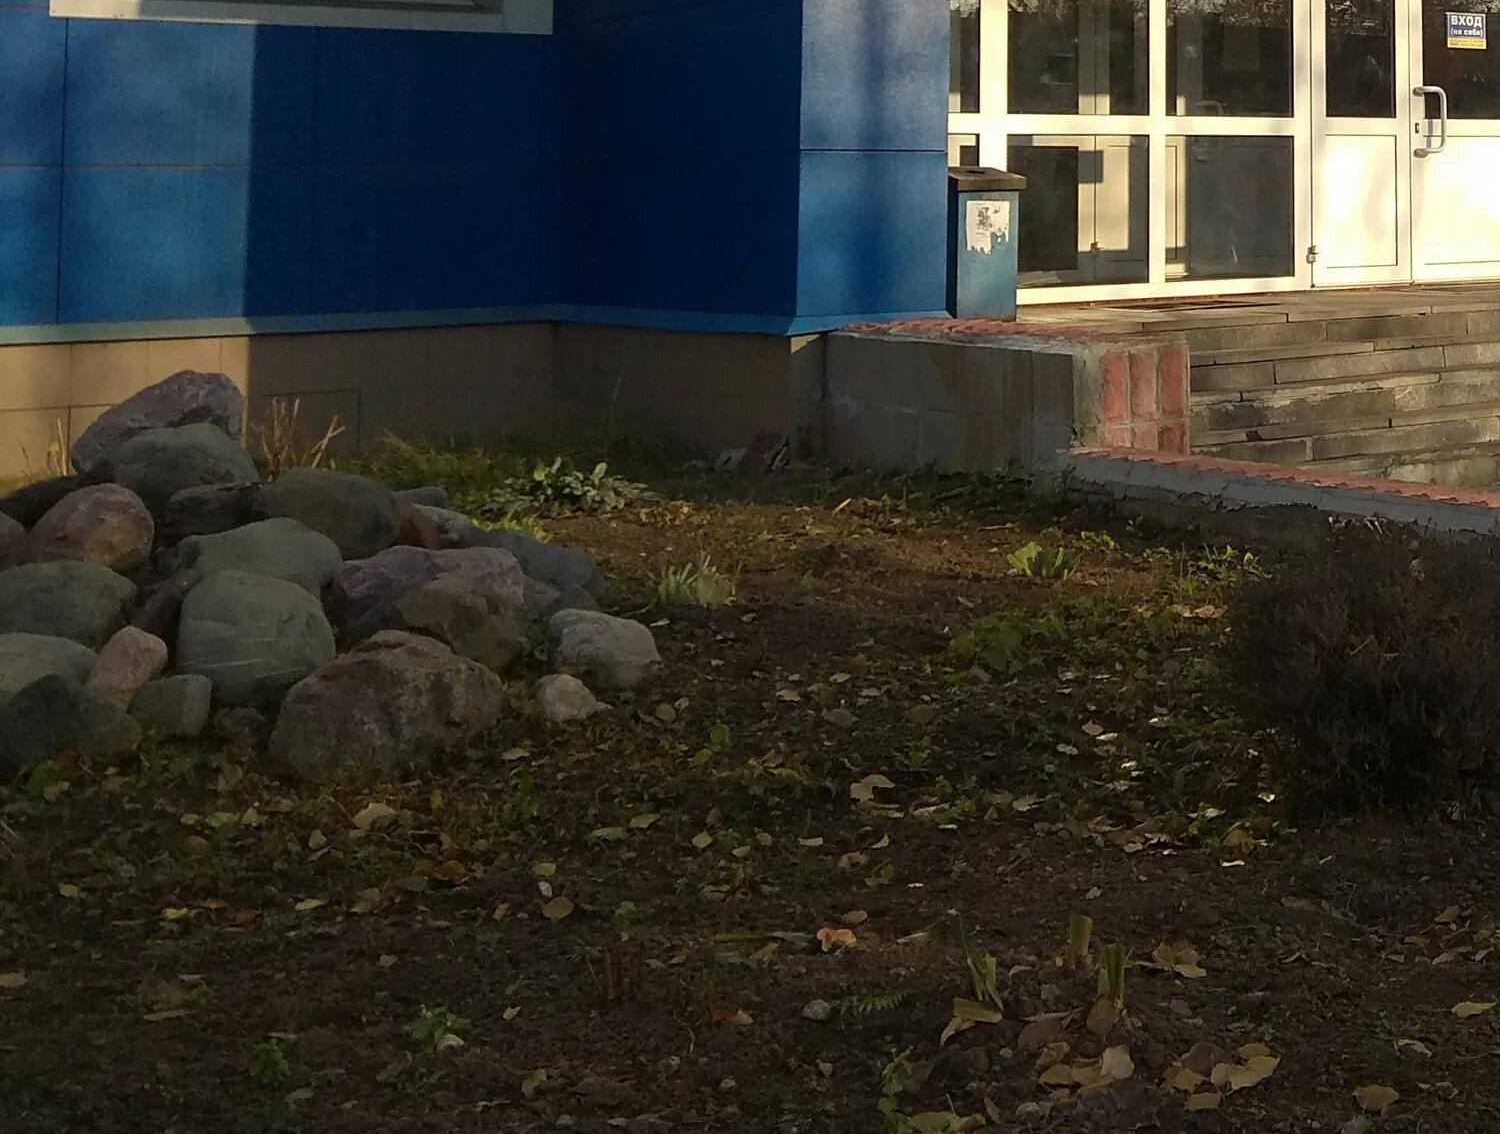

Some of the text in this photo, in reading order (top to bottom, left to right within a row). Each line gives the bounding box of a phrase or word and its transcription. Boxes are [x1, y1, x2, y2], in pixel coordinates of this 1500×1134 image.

[1450, 15, 1482, 28] ВХОД
[1450, 27, 1483, 37] (на себя)
